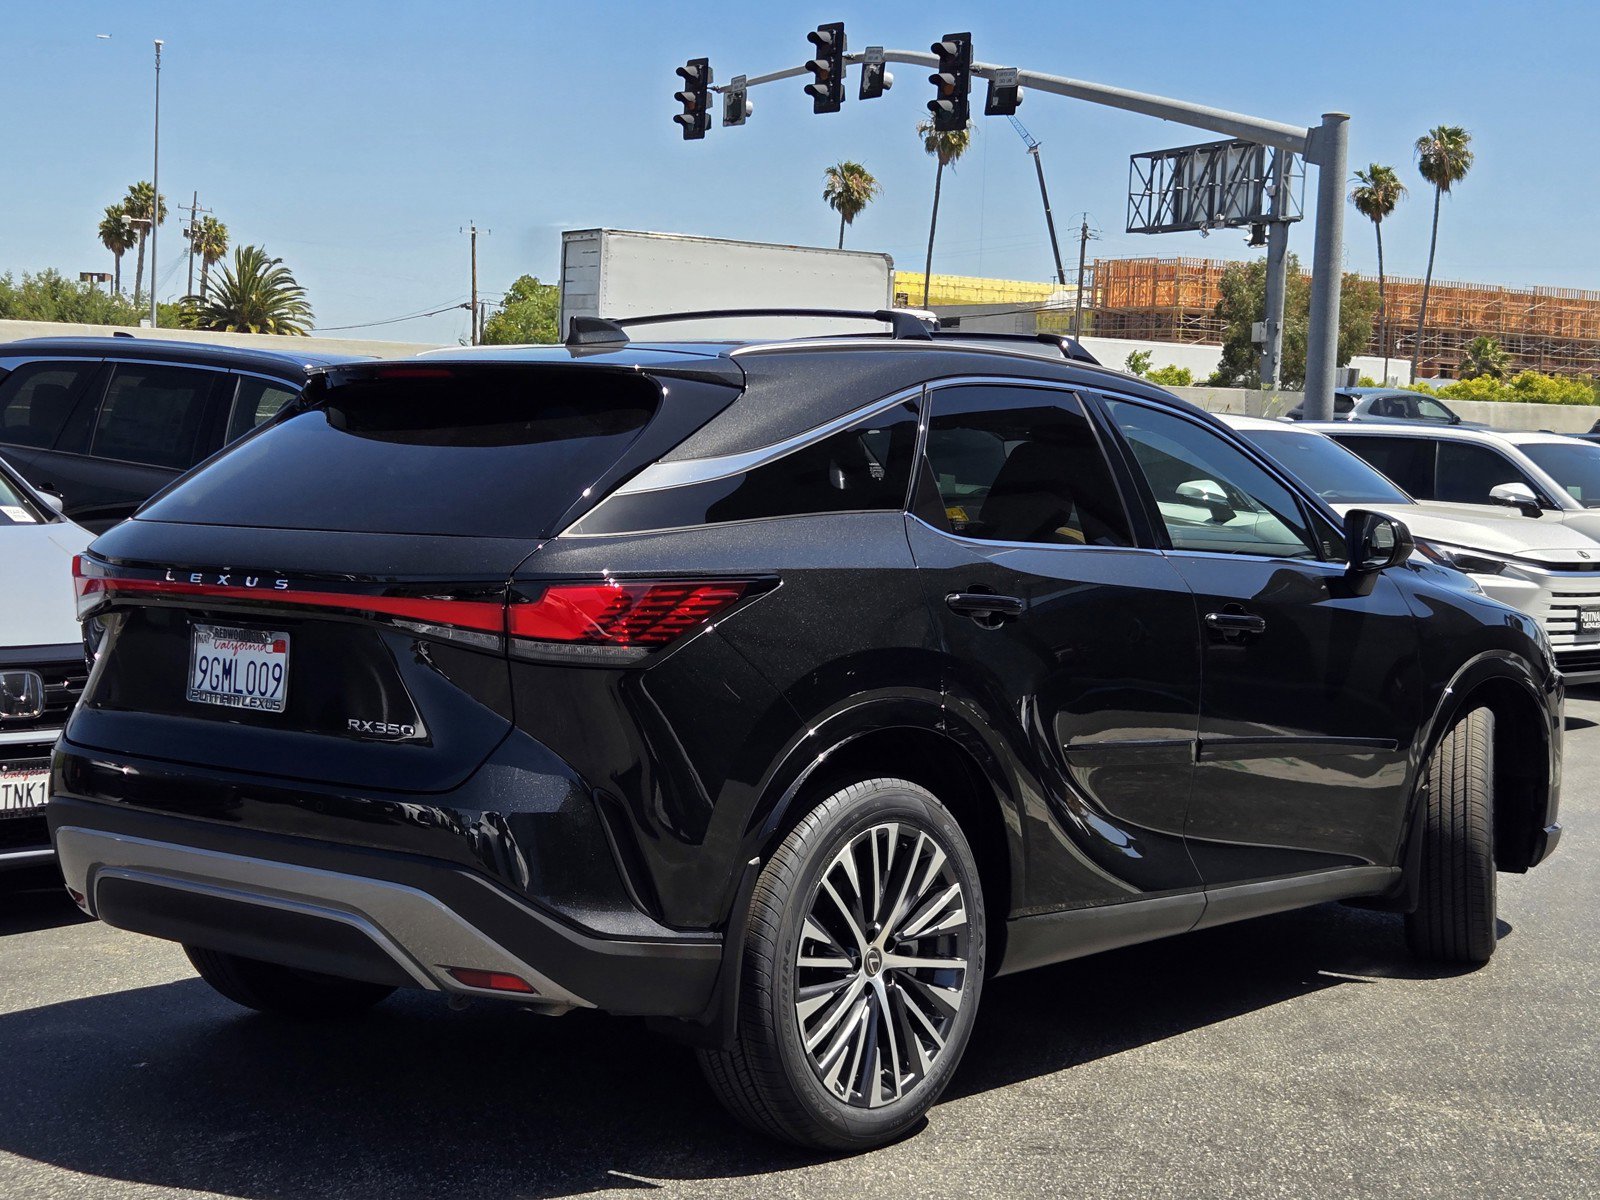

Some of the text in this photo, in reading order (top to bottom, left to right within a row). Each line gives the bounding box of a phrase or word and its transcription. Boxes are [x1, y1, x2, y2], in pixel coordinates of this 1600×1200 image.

[165, 570, 289, 590] LEXUS
[214, 639, 266, 656] California
[197, 655, 283, 698] 9GML009
[241, 696, 281, 710] LEXUS
[347, 718, 415, 736] RX350
